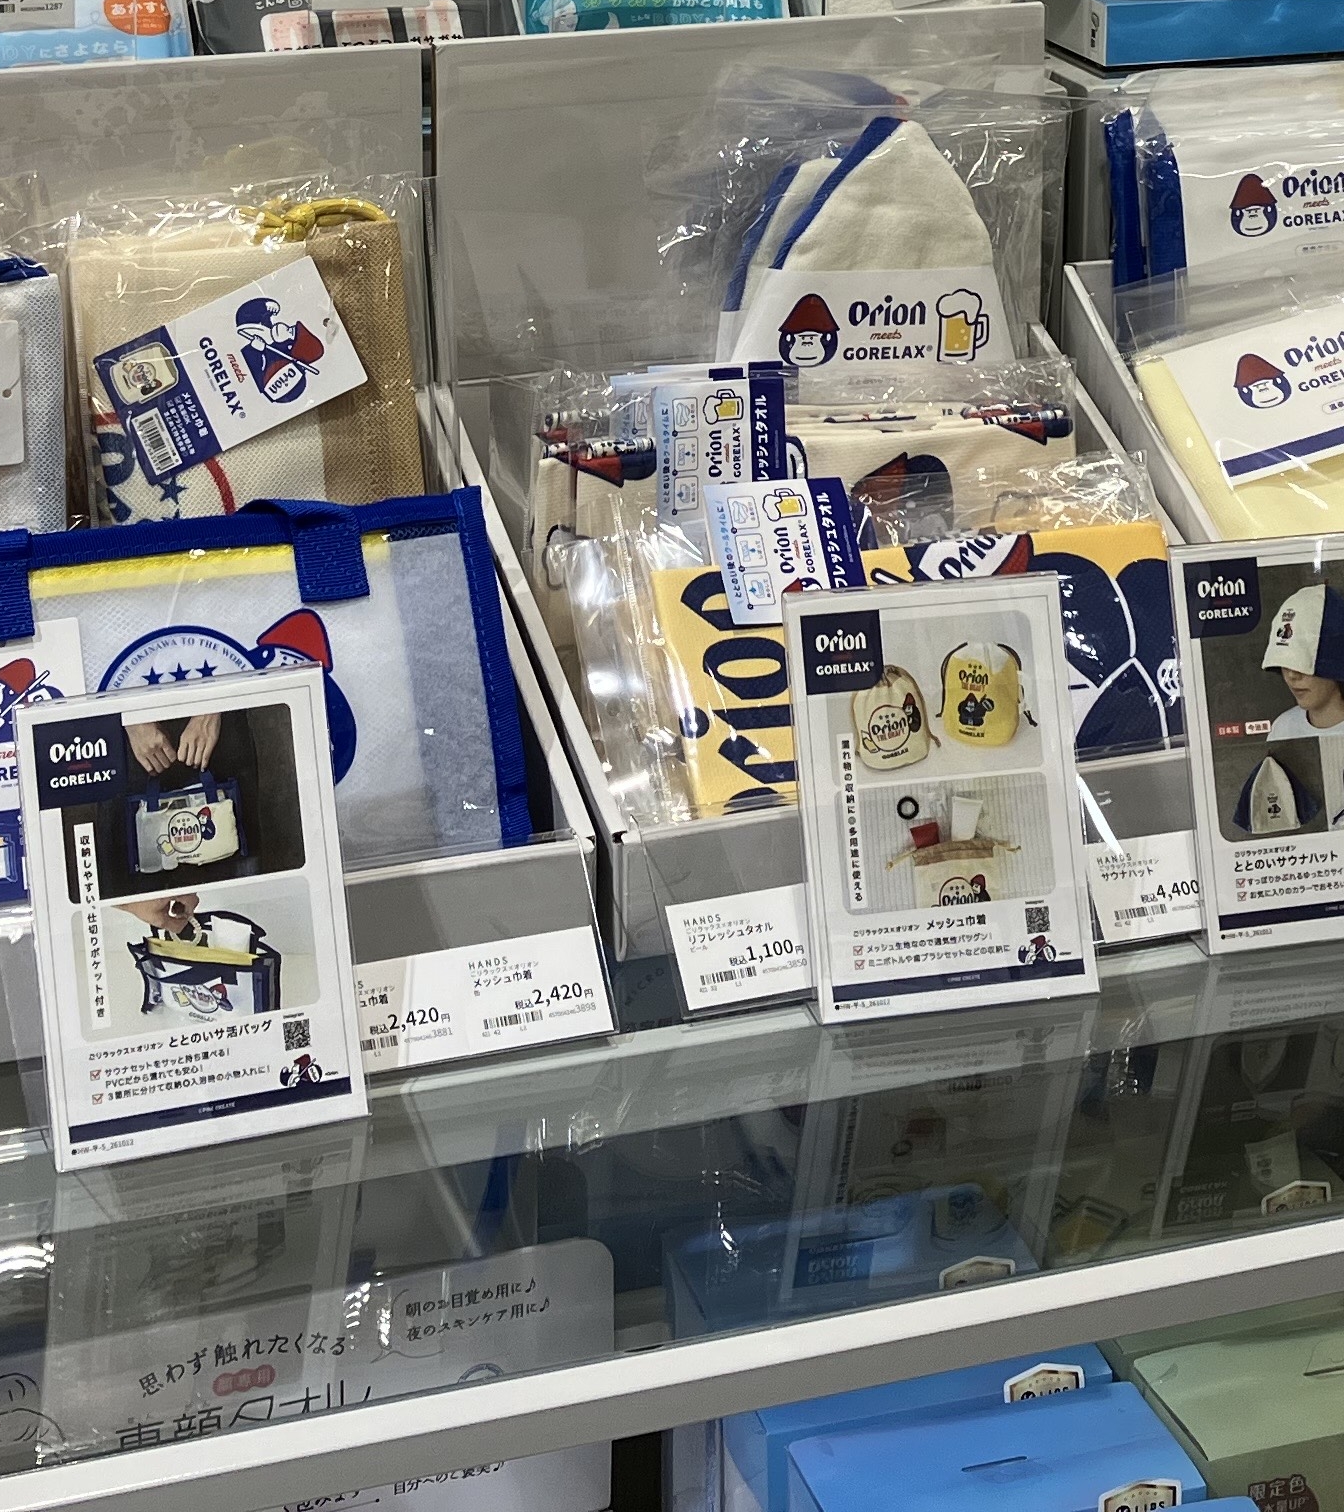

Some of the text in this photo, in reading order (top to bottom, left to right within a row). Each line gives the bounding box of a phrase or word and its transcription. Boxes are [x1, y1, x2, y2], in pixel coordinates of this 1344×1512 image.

[1302, 196, 1331, 208] meets
[847, 294, 927, 328] Orion
[869, 329, 903, 342] meets
[1313, 357, 1343, 372] meets
[705, 428, 723, 478] Orion
[773, 526, 795, 574] Orion
[1197, 575, 1246, 598] Orion
[815, 630, 868, 653] Orion
[1218, 724, 1241, 736] 日本製
[49, 735, 108, 765] Orion
[1100, 865, 1155, 881] サウナハット
[1232, 849, 1340, 873] ととのいサウナハット
[682, 914, 722, 928] HANDS
[687, 921, 775, 945] リフレッシュタオル
[926, 913, 987, 931] メッシュ巾着
[468, 955, 509, 970] HANDS
[728, 938, 805, 967] 税込1,100円
[473, 970, 534, 988] メッシュ巾着
[514, 982, 594, 1010] 税込2,420円
[369, 1006, 451, 1035] 税込2,420円
[167, 1018, 274, 1049] ととのいサ活バッグ
[138, 1332, 346, 1398] 思わず触れたくなる
[1249, 1474, 1308, 1500] 限定色
